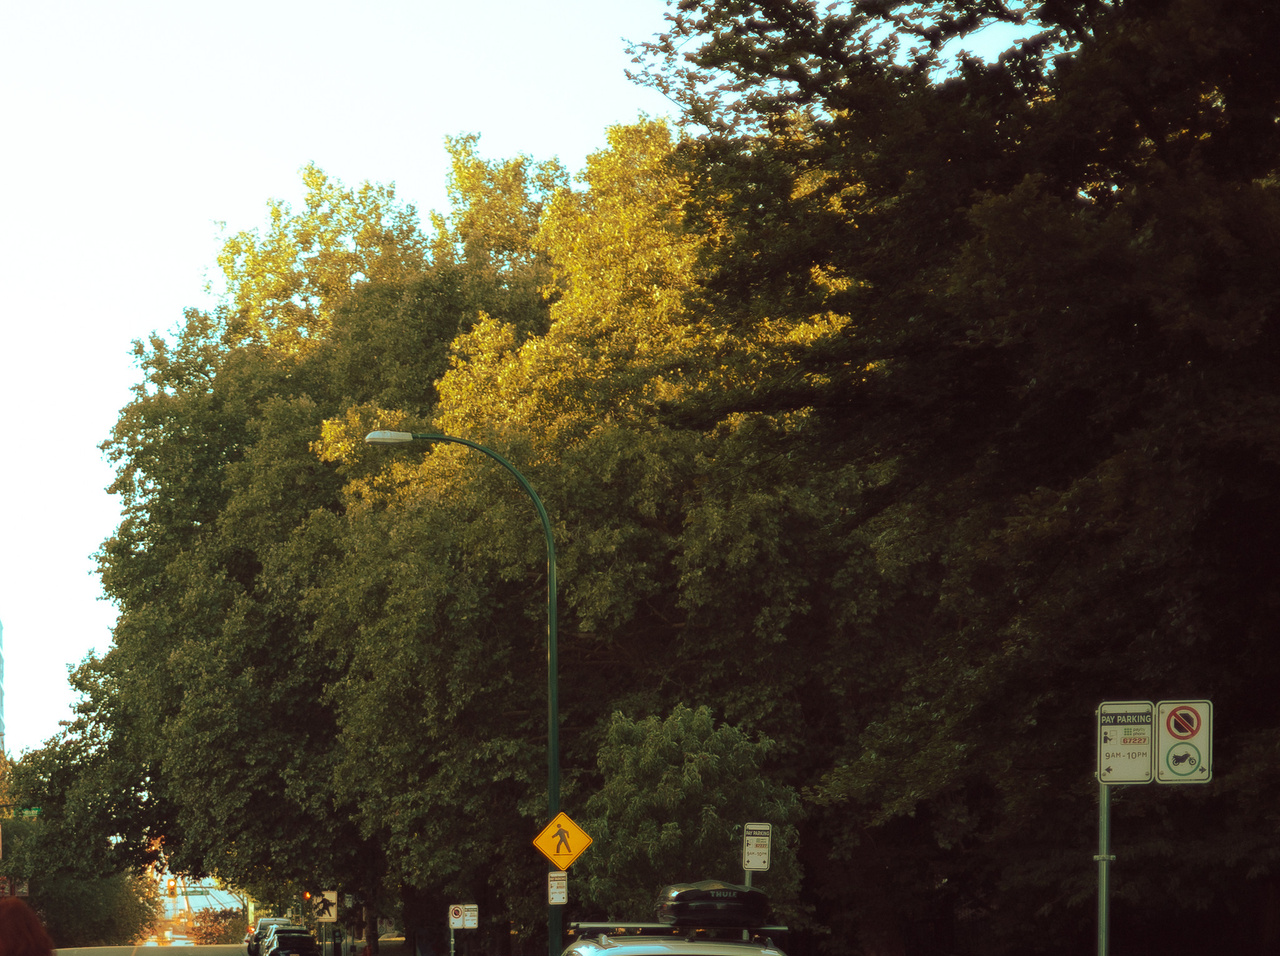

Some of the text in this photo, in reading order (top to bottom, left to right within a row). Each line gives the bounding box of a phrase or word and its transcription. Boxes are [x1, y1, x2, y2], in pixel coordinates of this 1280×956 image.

[1101, 714, 1152, 724] PAY PARKING
[1105, 752, 1121, 760] 9AM
[1127, 751, 1147, 760] 10PM
